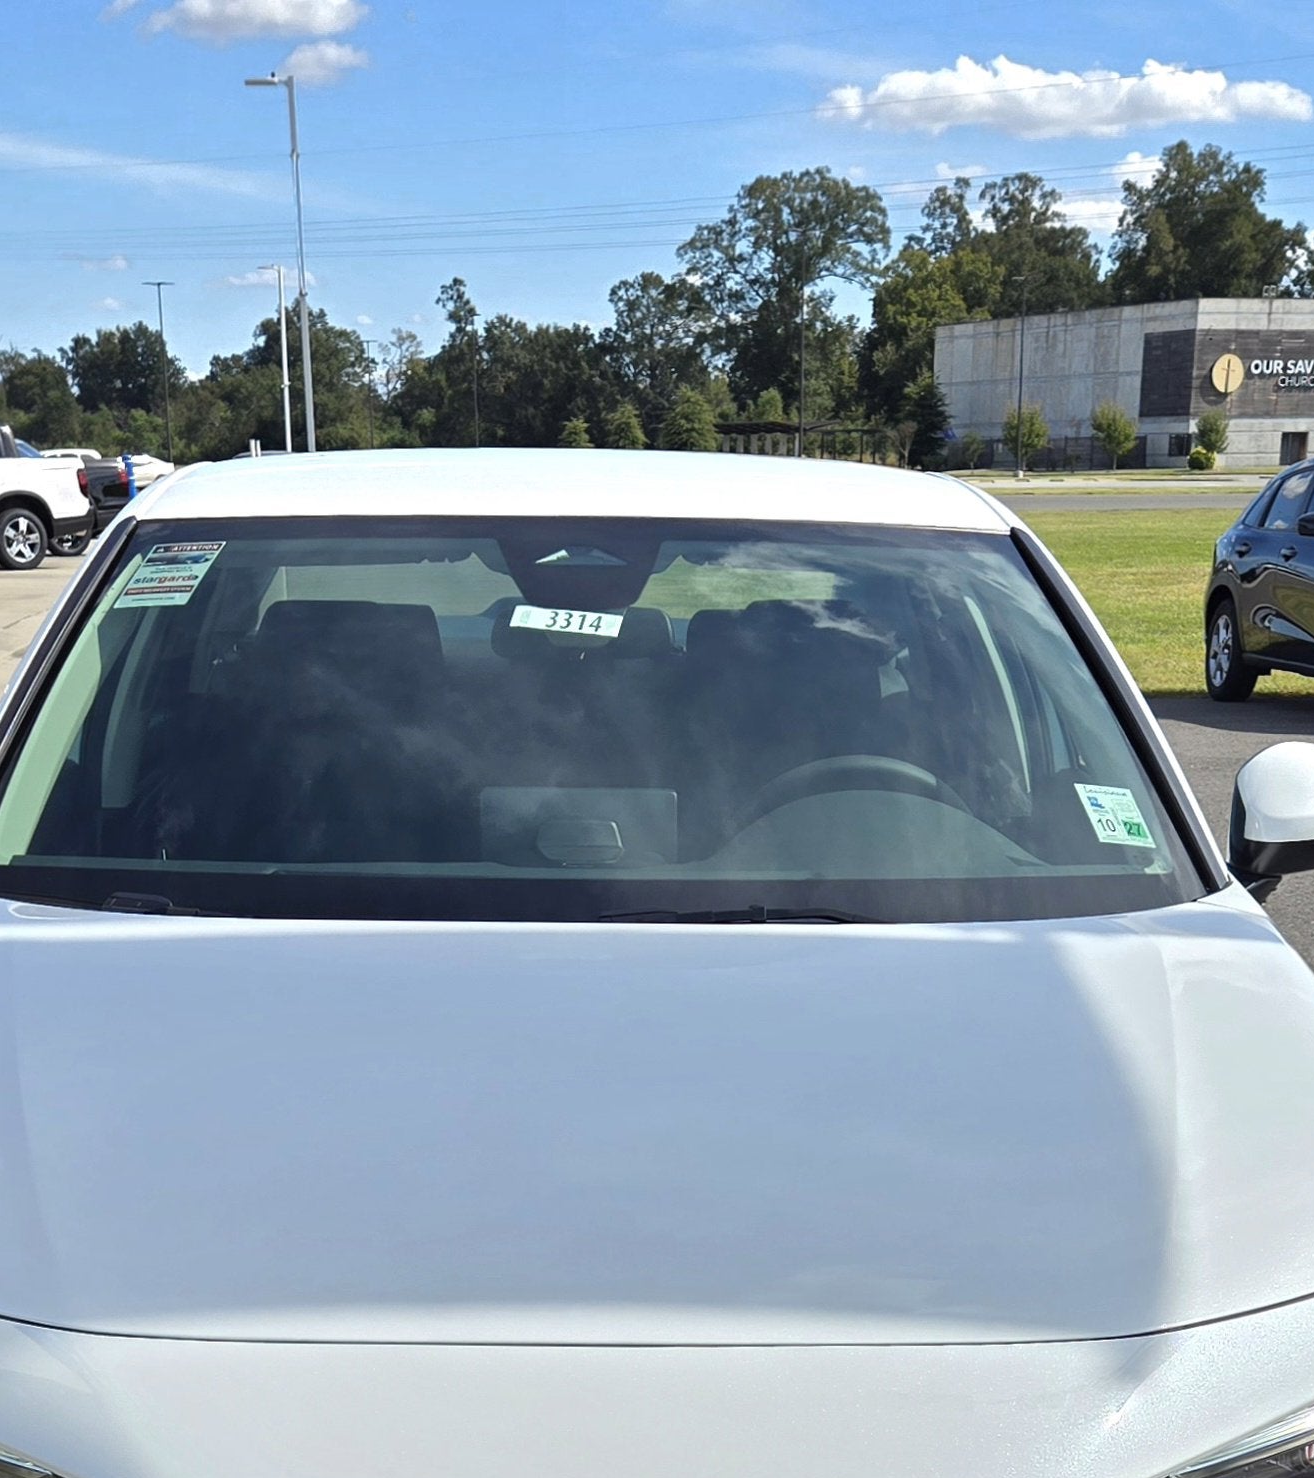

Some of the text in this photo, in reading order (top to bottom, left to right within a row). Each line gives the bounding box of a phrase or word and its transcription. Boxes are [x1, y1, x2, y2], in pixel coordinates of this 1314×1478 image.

[1251, 360, 1283, 374] OUR
[171, 543, 219, 552] ATTENTION
[545, 611, 603, 632] 3314
[1096, 818, 1117, 833] 10
[1123, 821, 1143, 837] 27
